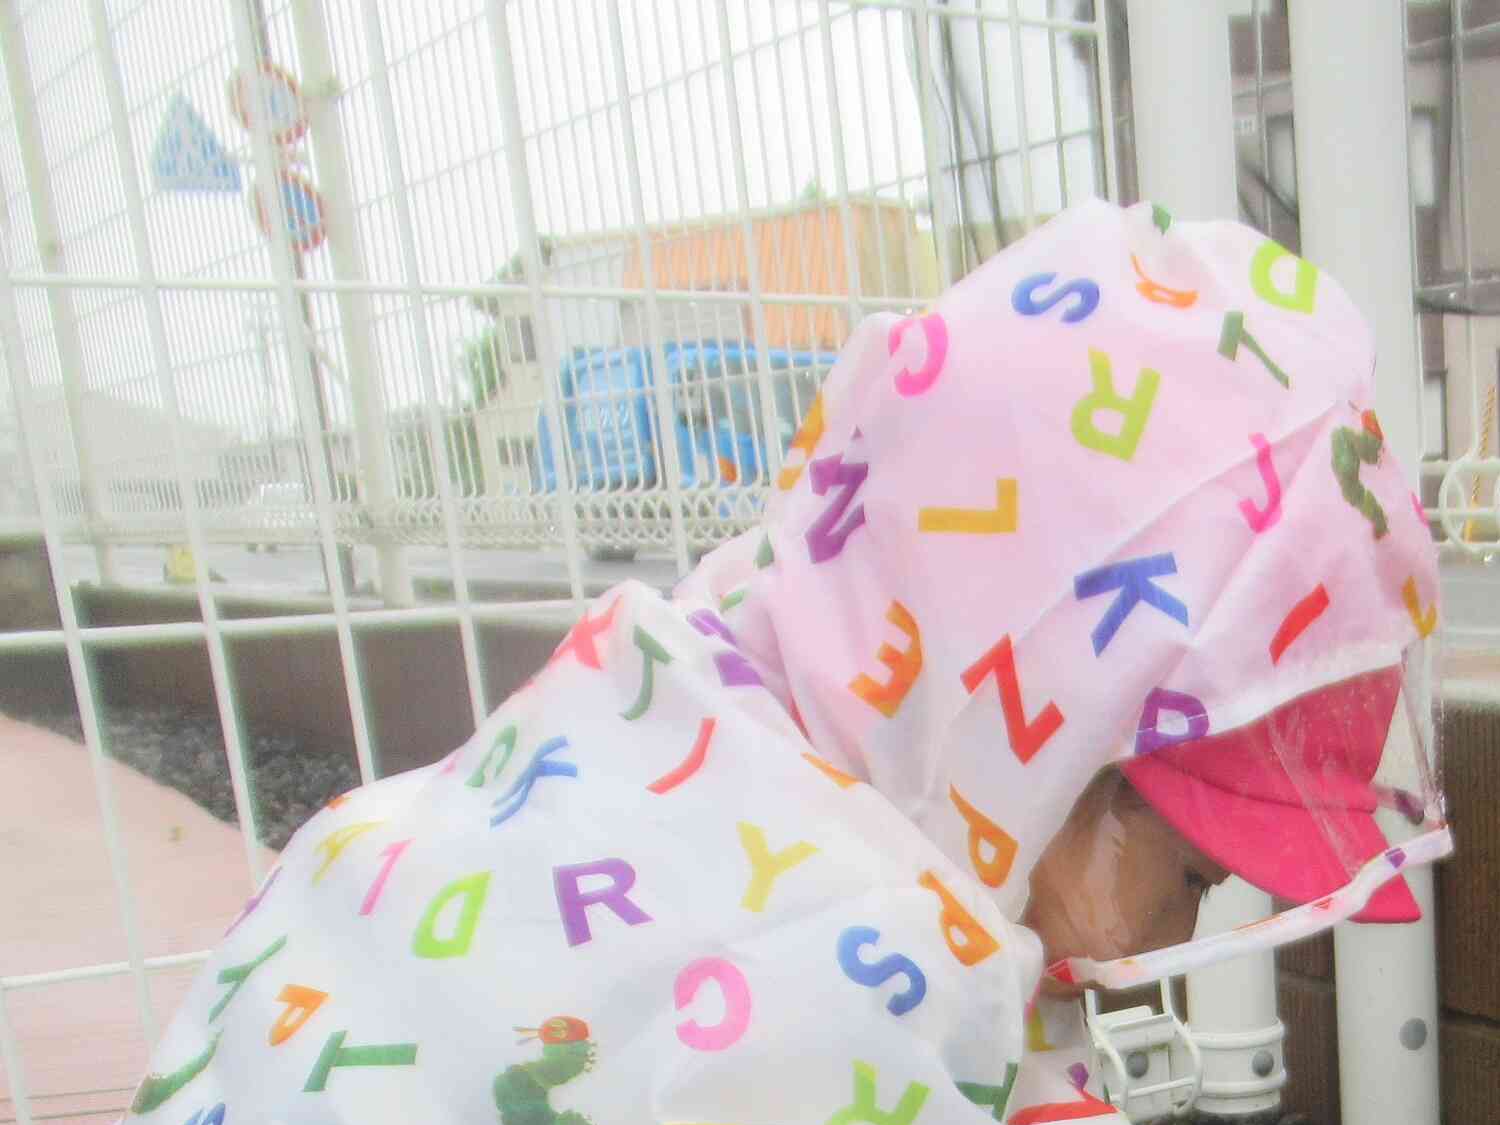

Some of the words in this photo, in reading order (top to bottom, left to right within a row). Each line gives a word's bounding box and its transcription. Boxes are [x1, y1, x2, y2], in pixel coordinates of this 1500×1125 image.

[1011, 272, 1100, 324] S
[1070, 345, 1161, 461] R
[918, 477, 1019, 534] L
[1074, 551, 1189, 658] K
[851, 600, 925, 718] E
[738, 820, 819, 913] Y
[950, 783, 1019, 889] P
[553, 858, 654, 948] R
[837, 926, 927, 1018] S
[303, 1030, 418, 1092] T
